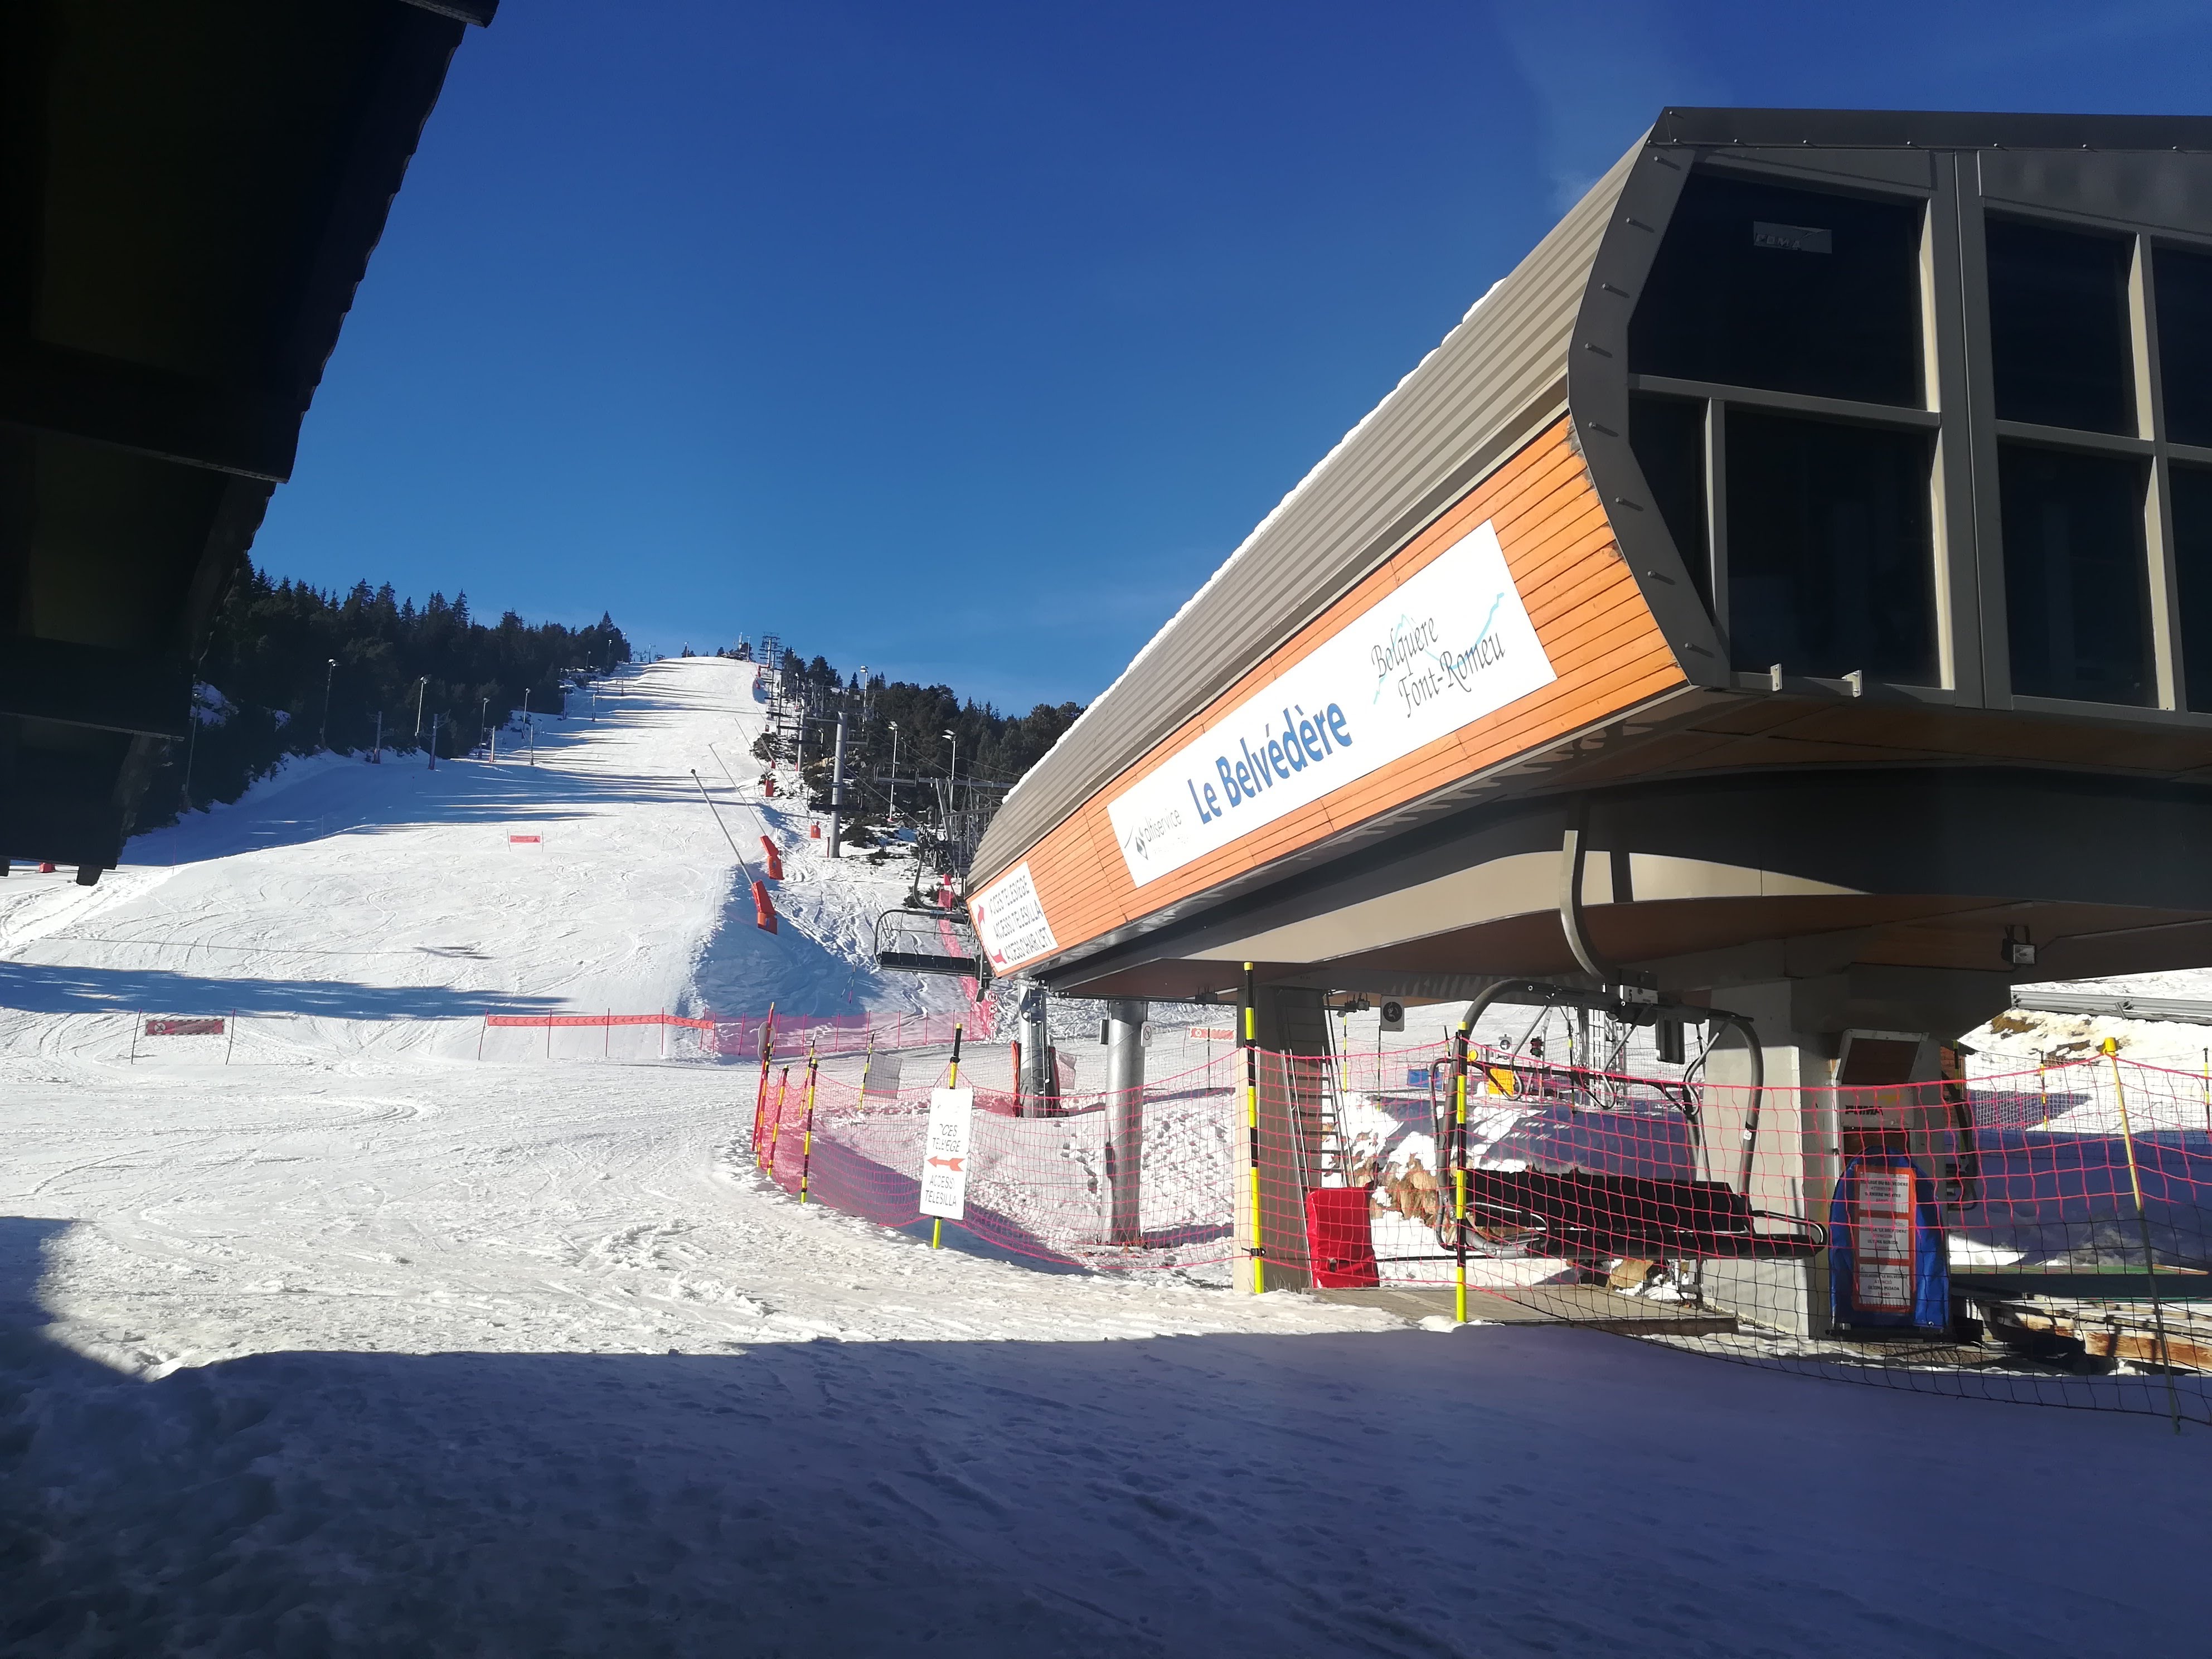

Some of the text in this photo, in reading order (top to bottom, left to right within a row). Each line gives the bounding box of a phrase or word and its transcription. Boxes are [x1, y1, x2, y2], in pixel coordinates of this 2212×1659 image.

[1371, 618, 1438, 678] Bolquère
[1398, 633, 1506, 718] Font-Romeu
[1187, 703, 1352, 824] Le Belvédère
[1144, 808, 1182, 842] altiservice
[993, 900, 1043, 940] ACCESSO TELESILLA
[925, 1190, 957, 1206] TELESILLA
